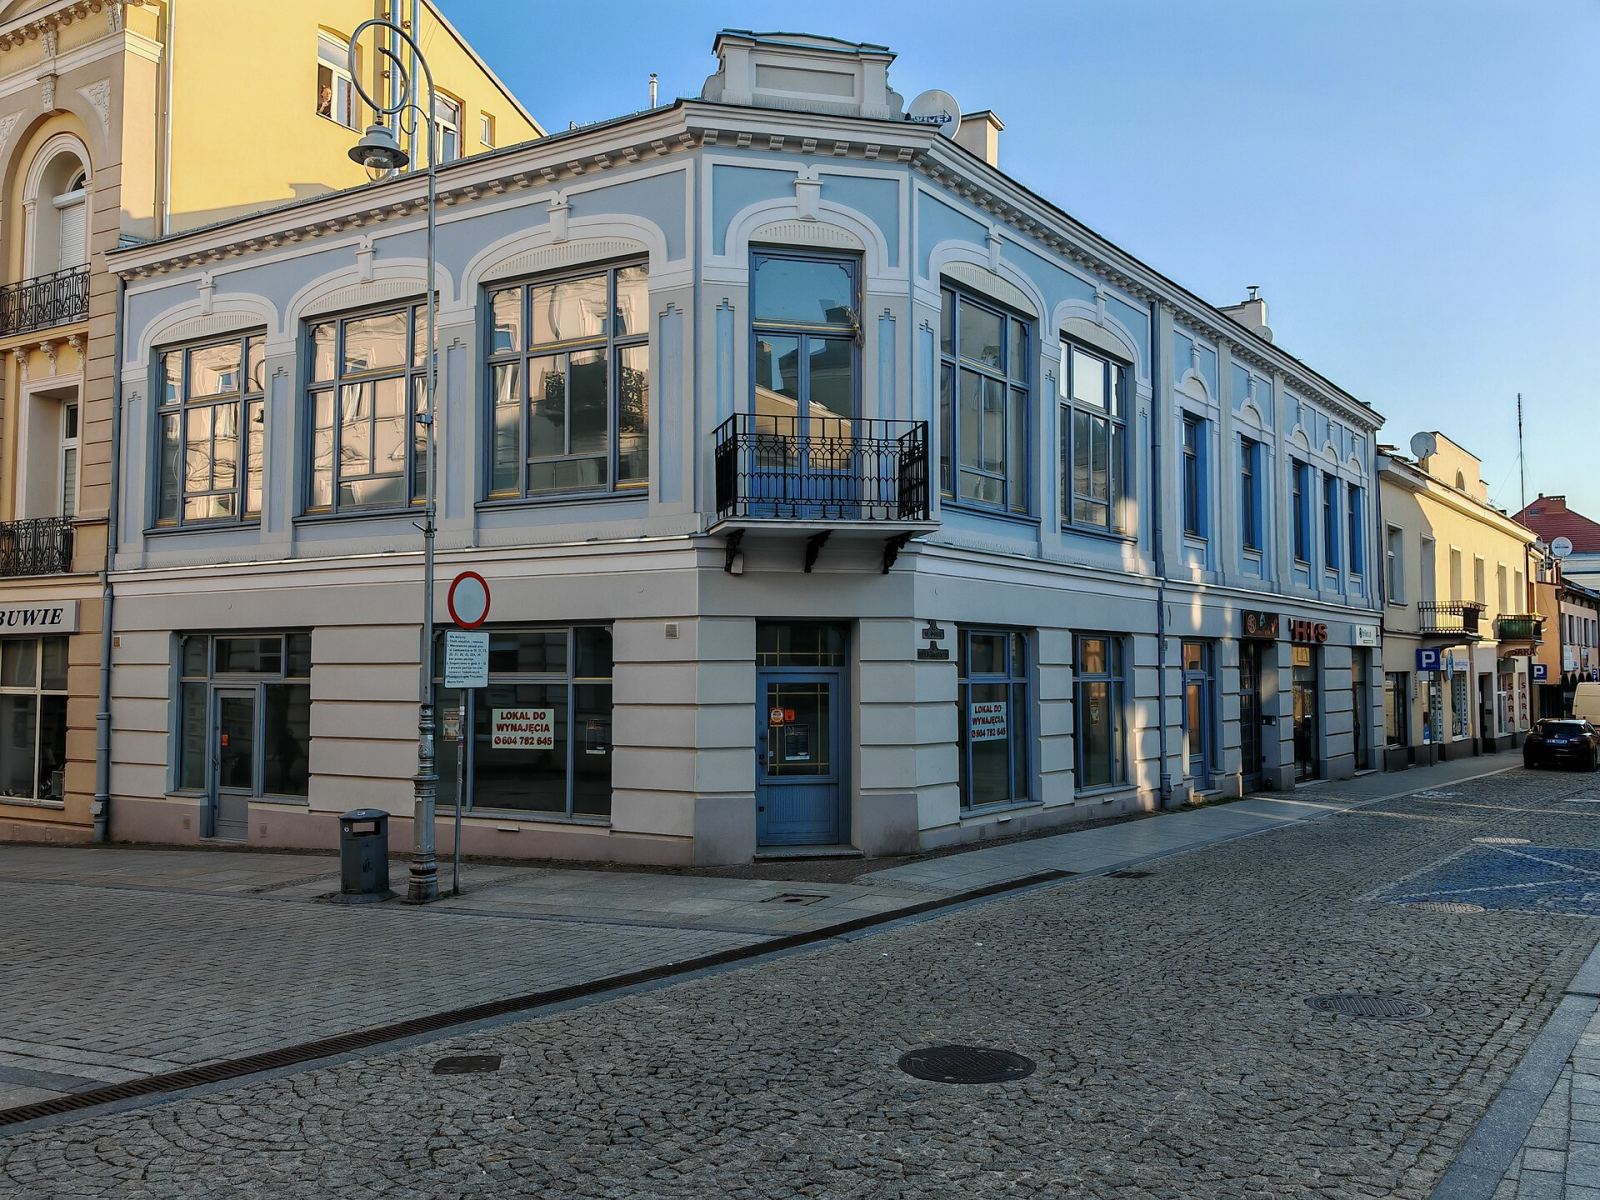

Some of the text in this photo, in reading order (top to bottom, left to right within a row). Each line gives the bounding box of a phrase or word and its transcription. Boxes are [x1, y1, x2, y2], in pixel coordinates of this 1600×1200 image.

[1421, 651, 1435, 668] P
[1533, 665, 1544, 678] P
[974, 704, 1002, 714] LOKAL DO
[500, 711, 546, 720] LOKAL DO
[972, 716, 1005, 726] WYNAJĘCIA
[496, 723, 550, 734] WYNAJĘCIA
[976, 727, 1006, 737] 604 782 645
[502, 736, 552, 745] 604 782 645
